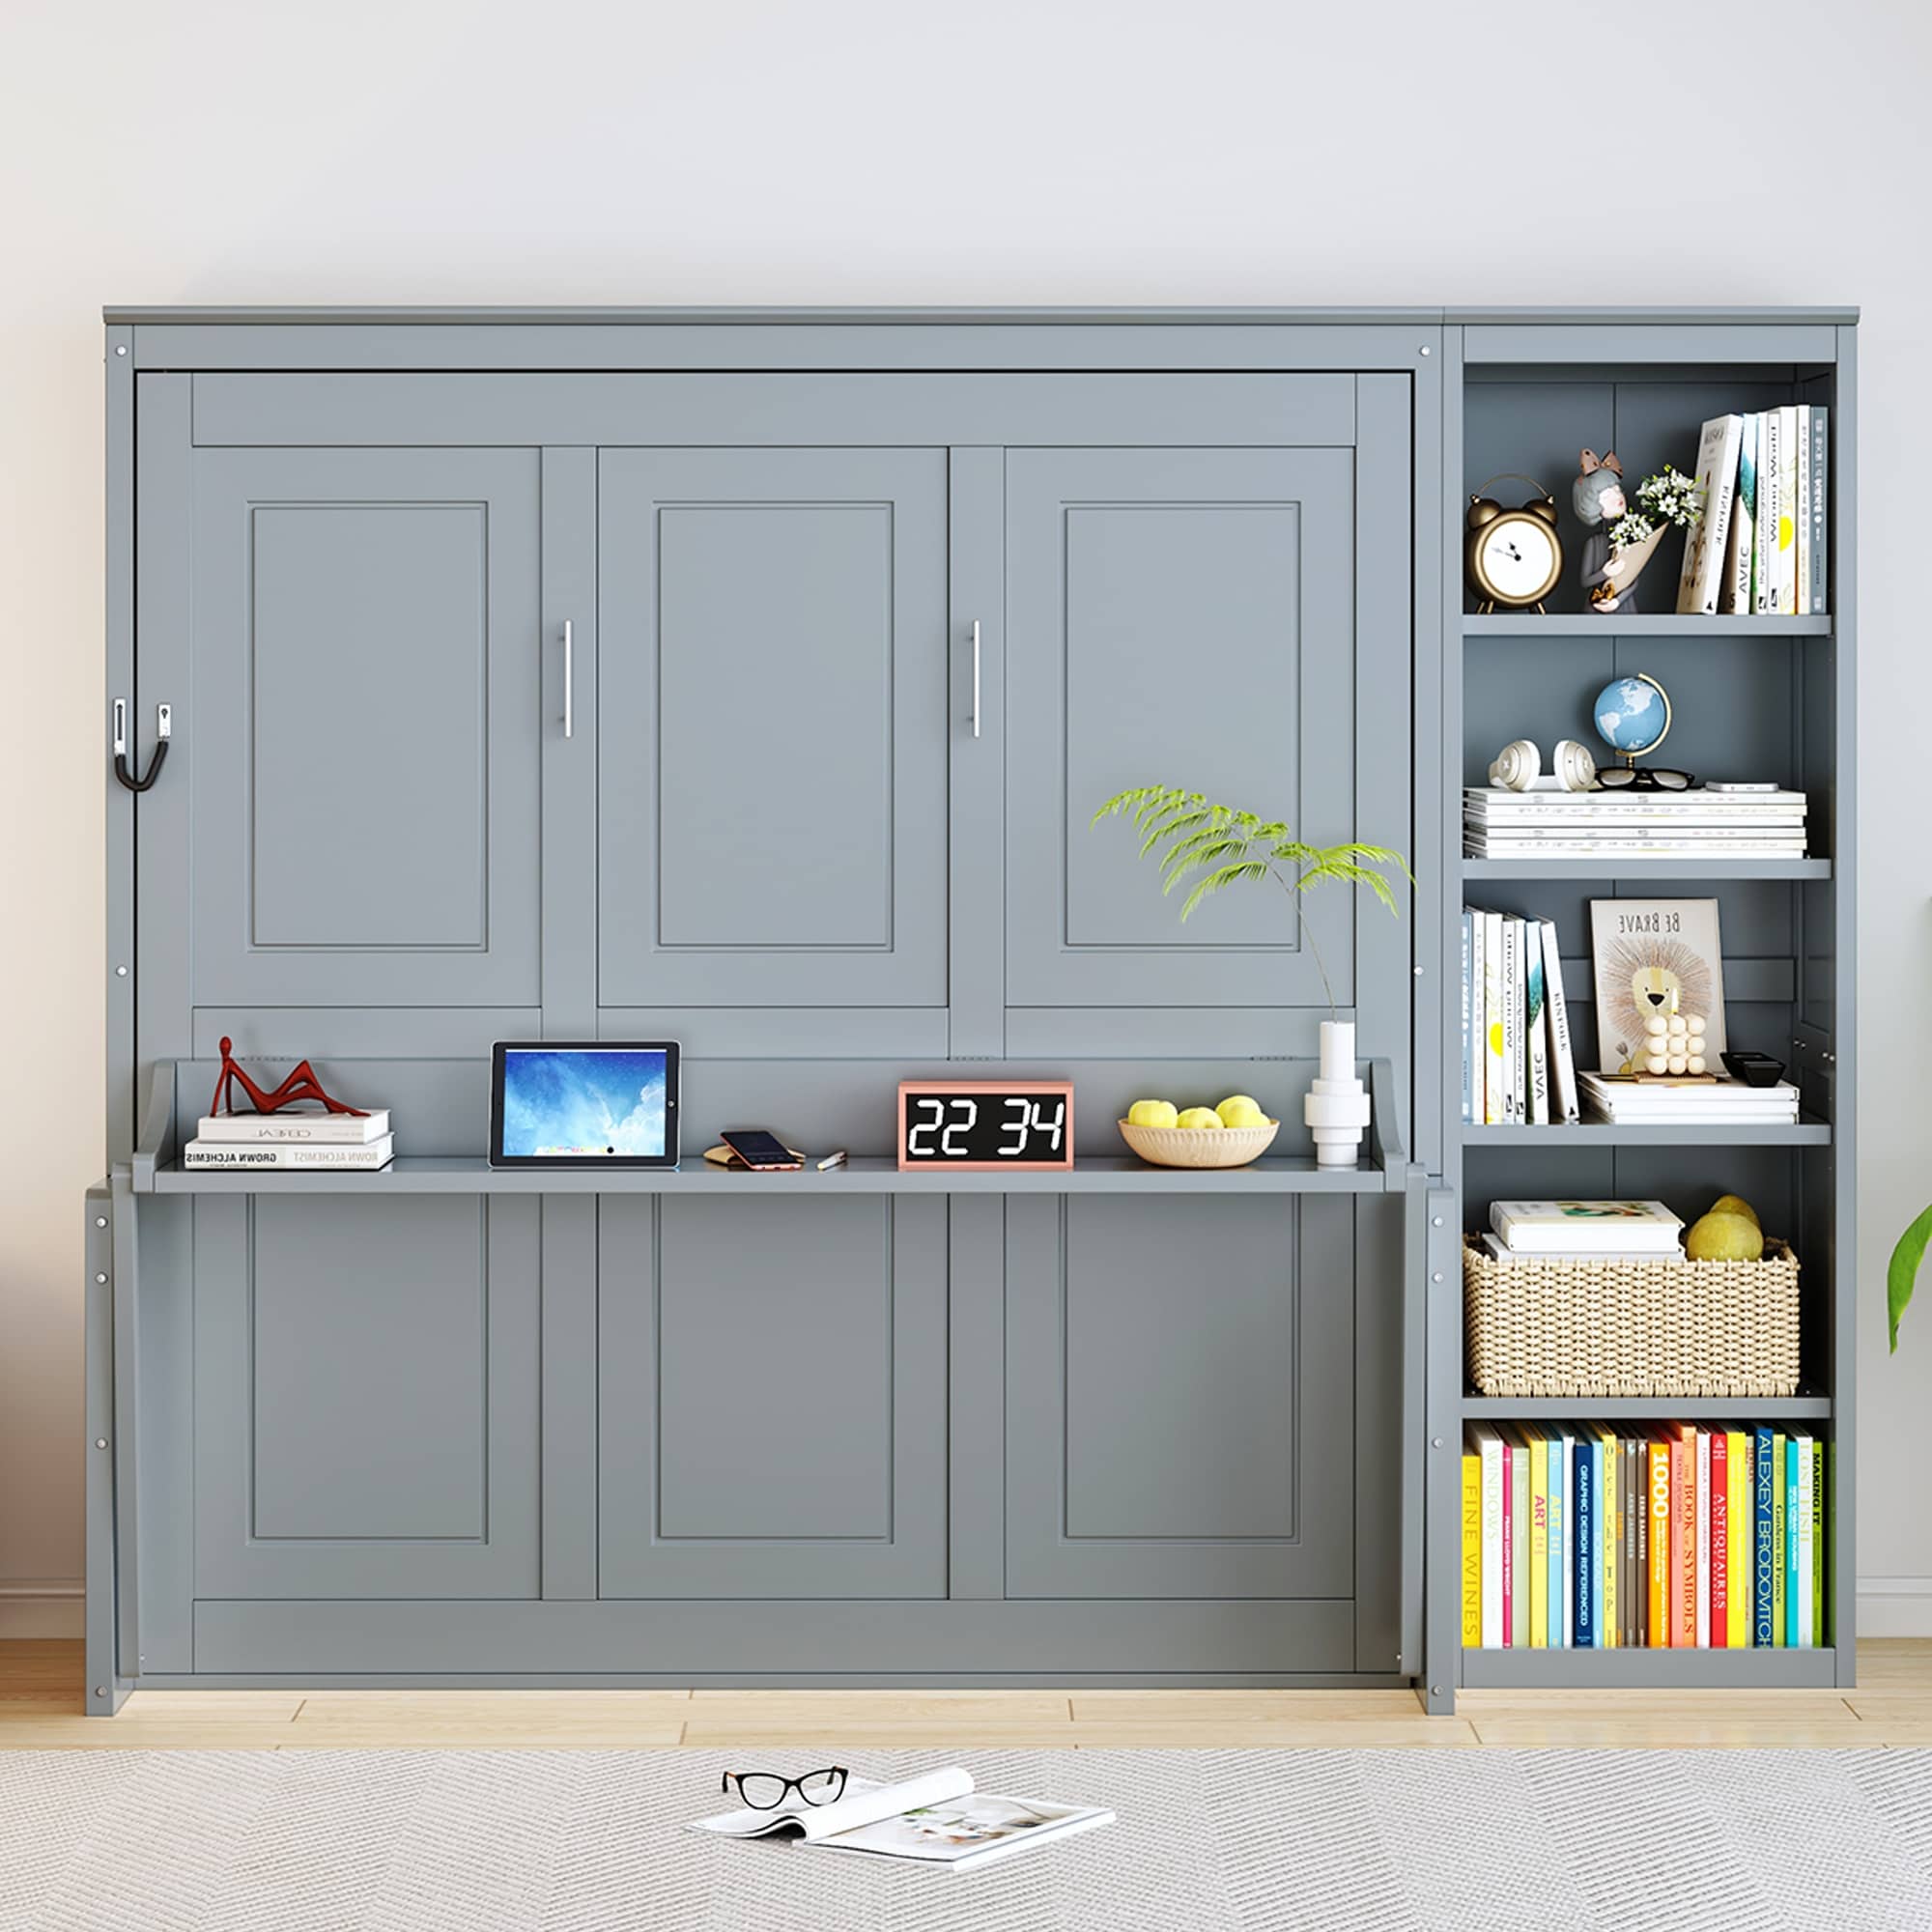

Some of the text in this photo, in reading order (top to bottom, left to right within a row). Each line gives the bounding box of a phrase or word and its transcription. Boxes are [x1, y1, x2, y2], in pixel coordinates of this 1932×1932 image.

[1738, 545, 1749, 594] AVEC
[1553, 992, 1568, 1051] KINFOLK
[908, 1098, 1065, 1155] 22 34
[1487, 1448, 1499, 1541] WINDOWS
[1579, 1464, 1588, 1513] GRAPHIC
[1653, 1452, 1669, 1518] 1000
[1758, 1435, 1772, 1515] ALEXEY
[1800, 1443, 1810, 1543] LOST FISH
[1812, 1453, 1821, 1508] MAKING
[1534, 1494, 1546, 1530] ART
[1549, 1494, 1561, 1531] ART
[1579, 1515, 1588, 1554] DESIGN
[1684, 1484, 1693, 1531] BOOK
[1812, 1511, 1821, 1525] IT
[1464, 1485, 1478, 1636] FINE WINES
[1717, 1493, 1726, 1609] ANTIQUAIRES
[1775, 1504, 1783, 1605] Gardens in France
[1579, 1556, 1588, 1627] REFERENCED
[1684, 1549, 1693, 1634] SYMBOLS
